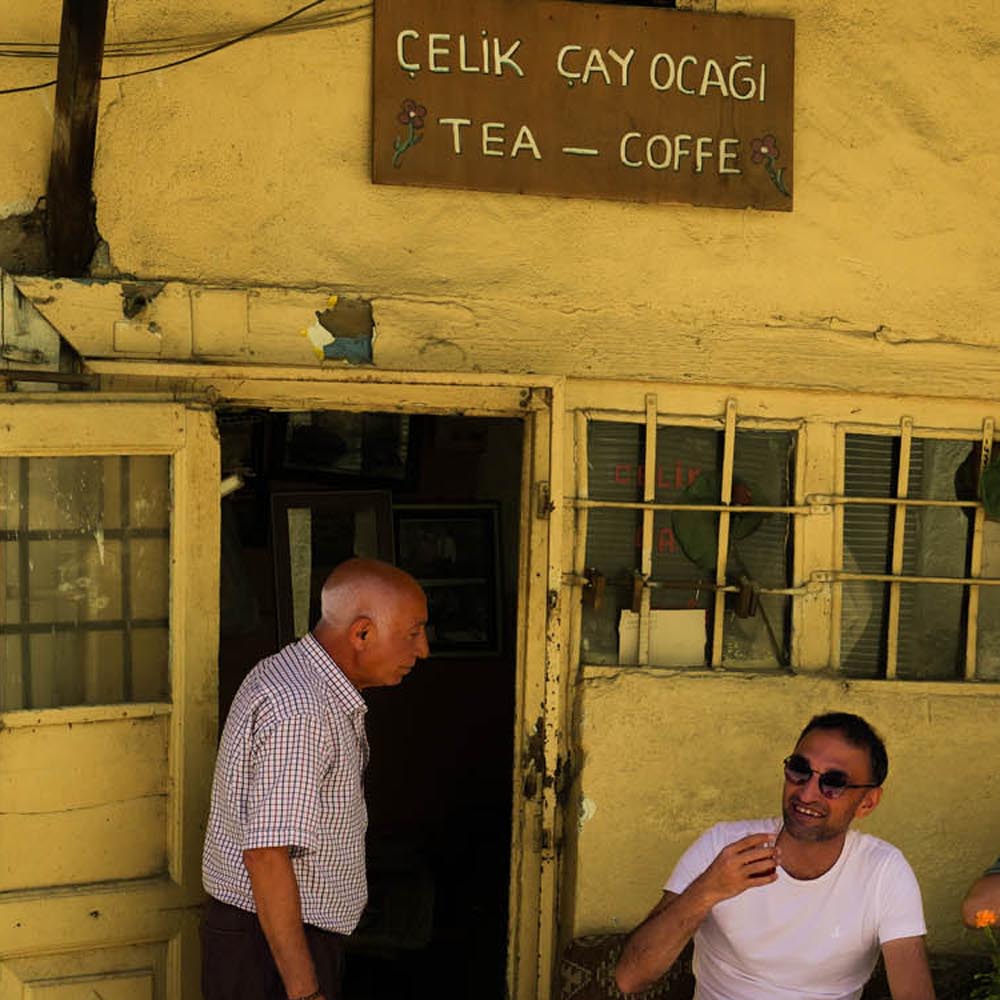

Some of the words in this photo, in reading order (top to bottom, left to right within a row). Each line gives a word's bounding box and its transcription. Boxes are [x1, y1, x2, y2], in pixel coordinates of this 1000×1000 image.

[396, 29, 525, 79] ÇELİK
[556, 44, 635, 86] ÇAY
[649, 52, 766, 101] OCAĞI
[438, 117, 543, 160] TEA
[619, 132, 742, 174] COFFE
